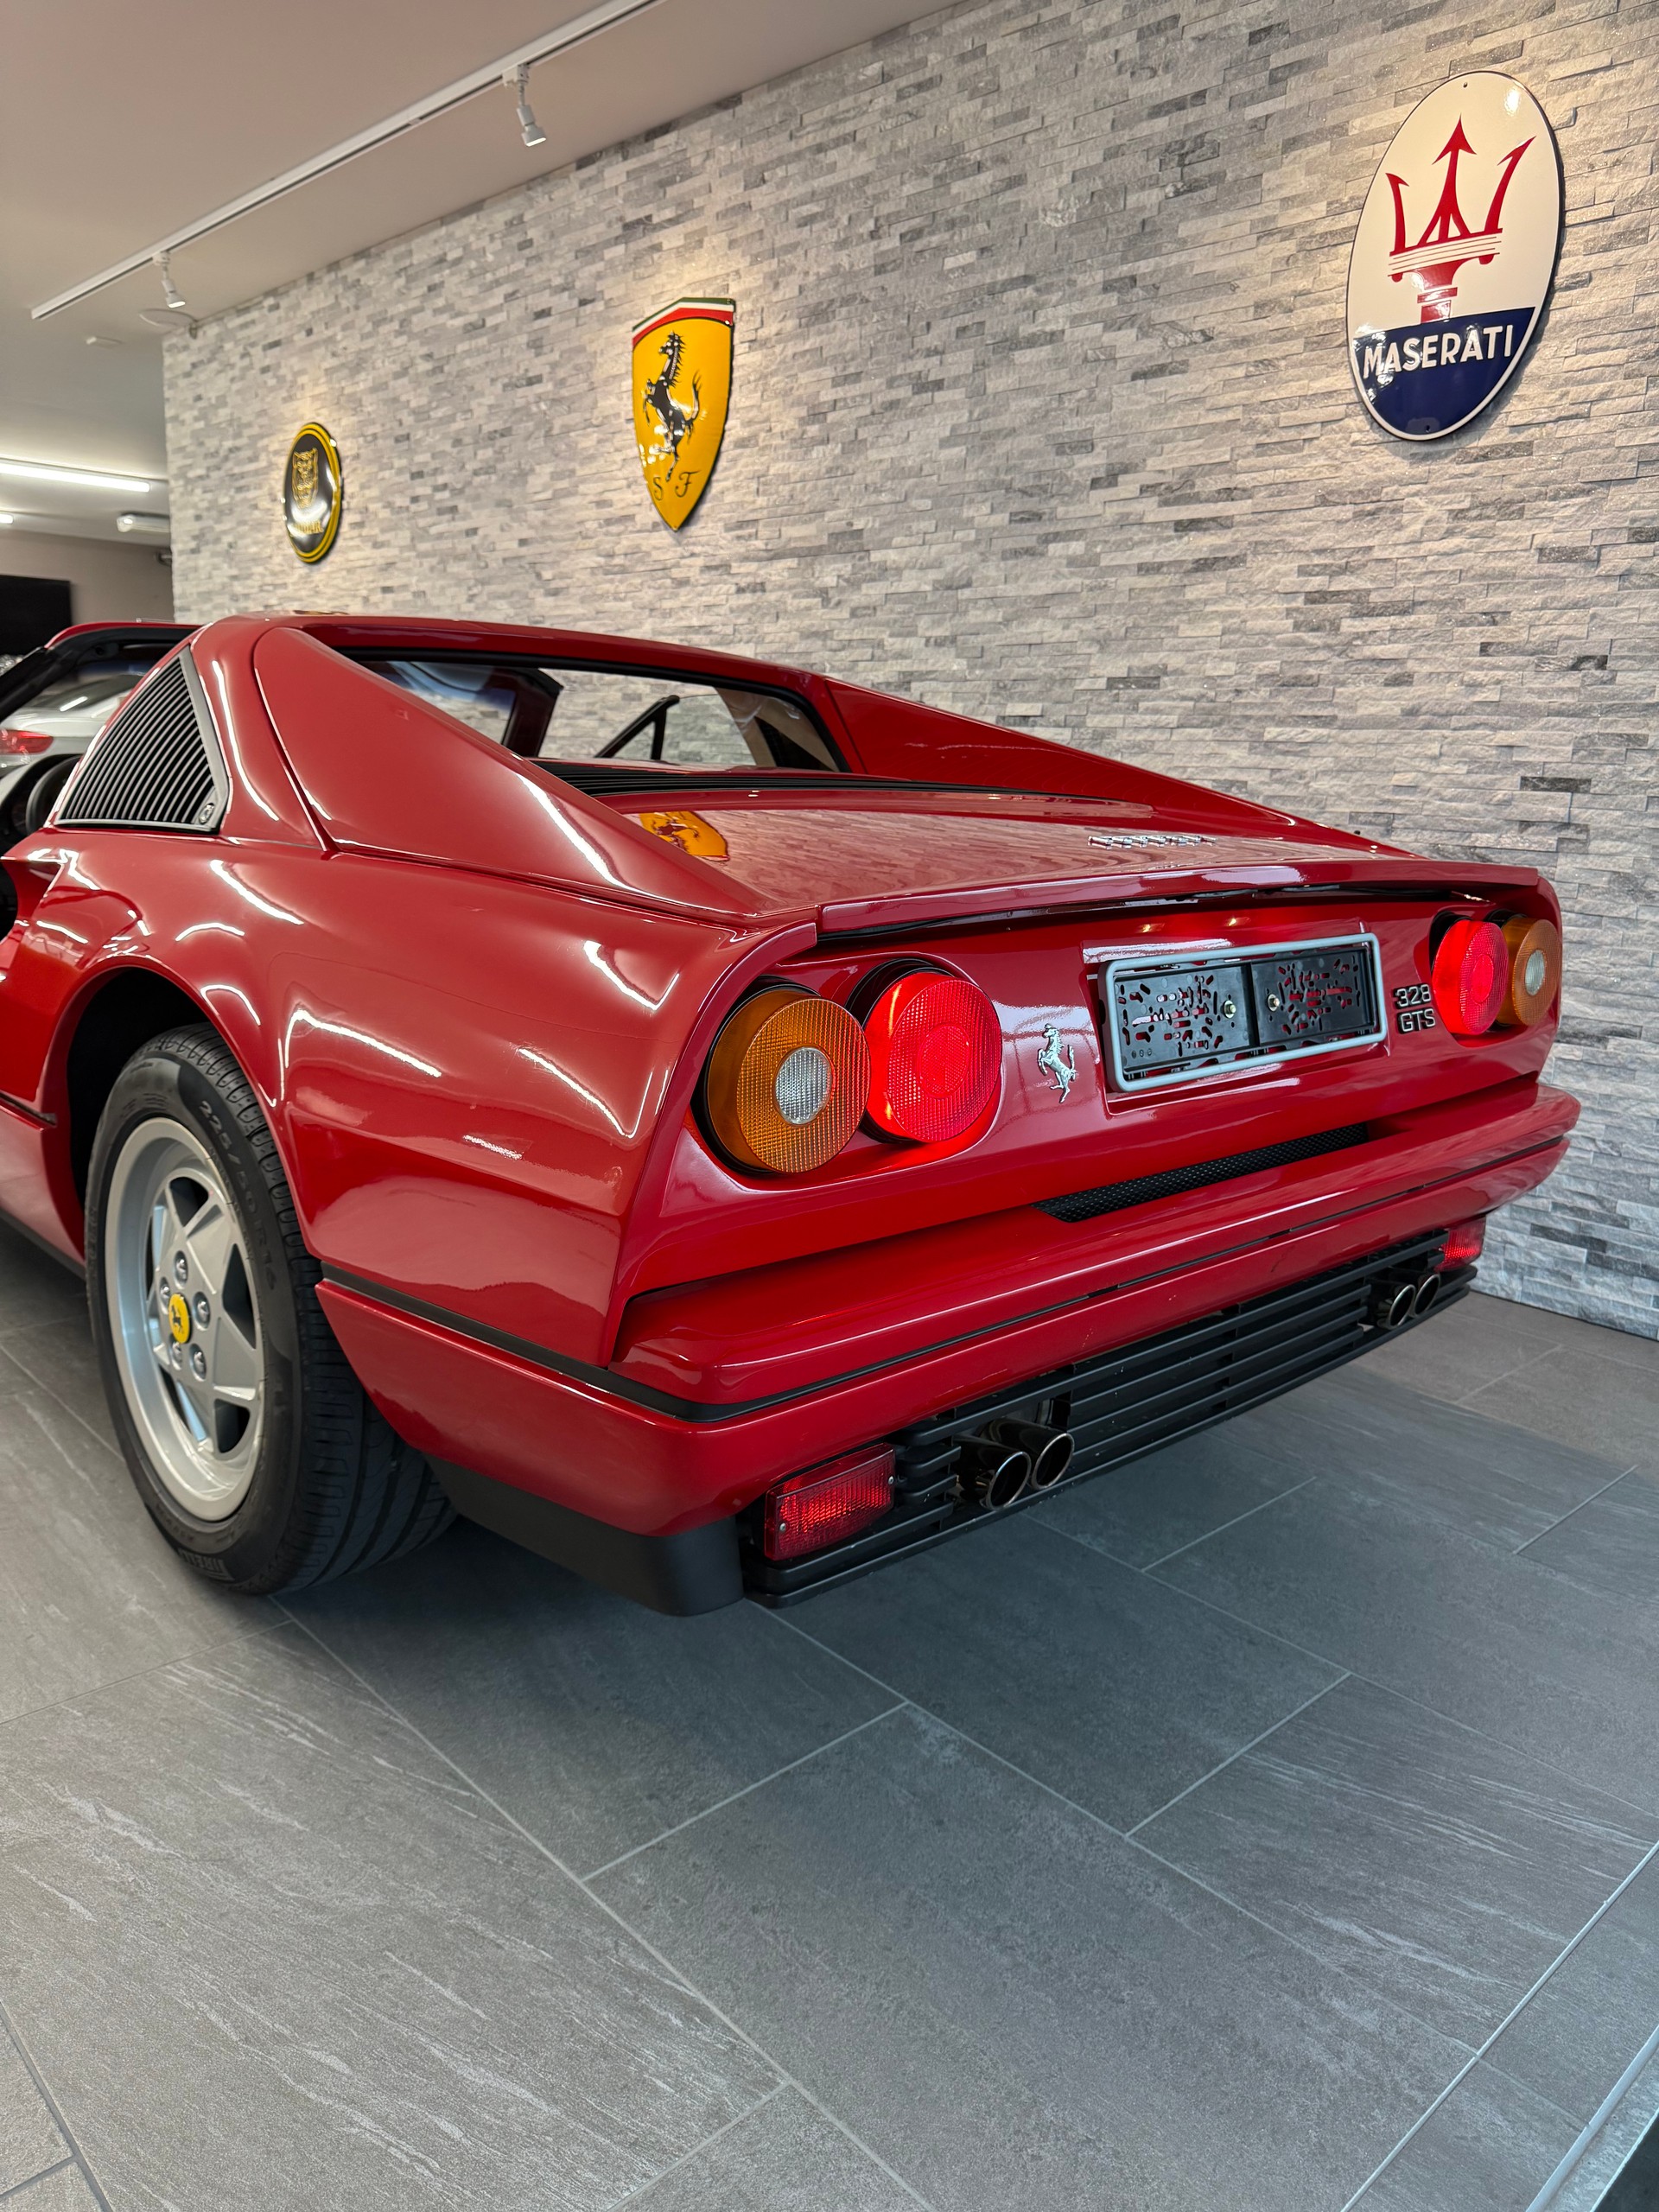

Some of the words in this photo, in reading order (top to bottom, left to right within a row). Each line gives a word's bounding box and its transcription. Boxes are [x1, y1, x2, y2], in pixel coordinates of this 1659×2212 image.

[1363, 325, 1514, 379] MASERATI
[652, 476, 664, 501] S
[675, 470, 701, 498] F
[1395, 983, 1432, 1007] 328
[1400, 1007, 1437, 1033] GTS
